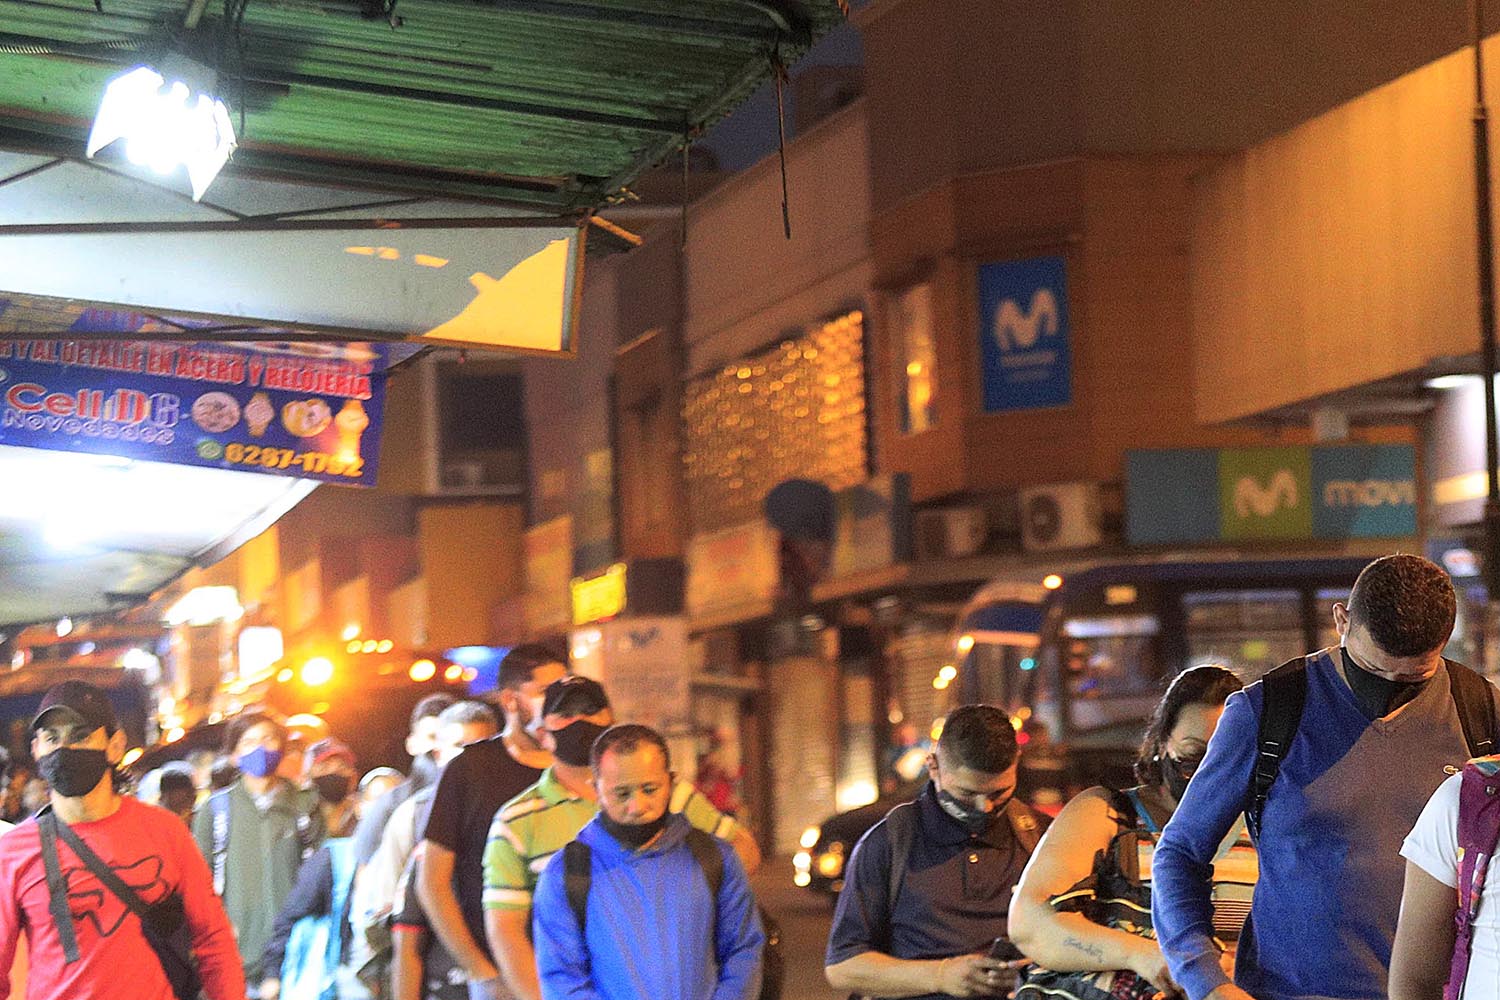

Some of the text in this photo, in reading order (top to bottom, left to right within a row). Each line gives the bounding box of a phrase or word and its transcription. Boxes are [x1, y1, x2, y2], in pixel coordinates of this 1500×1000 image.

[32, 340, 60, 363] AL
[60, 341, 143, 373] DETALLE
[146, 343, 174, 376] EN
[174, 347, 246, 385] ACERO
[248, 354, 265, 387] Y
